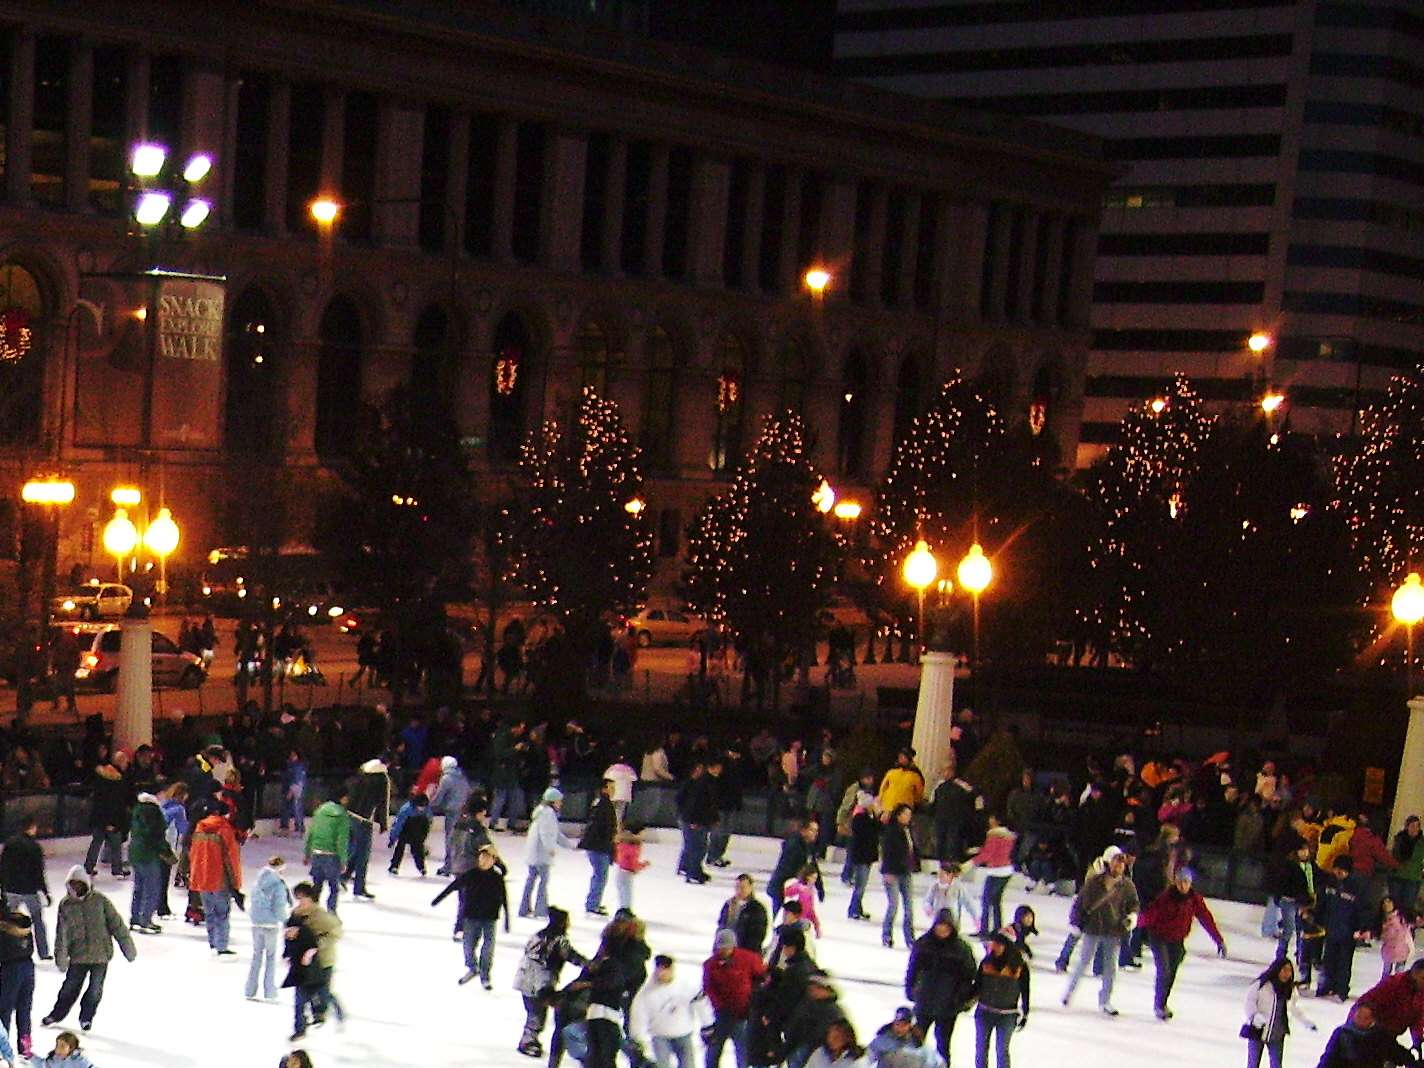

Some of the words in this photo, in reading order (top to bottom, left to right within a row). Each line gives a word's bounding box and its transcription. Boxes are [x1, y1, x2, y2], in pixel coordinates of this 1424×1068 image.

[159, 296, 224, 320] SNACK
[159, 318, 224, 336] EXPLORE
[159, 334, 220, 360] WALK
